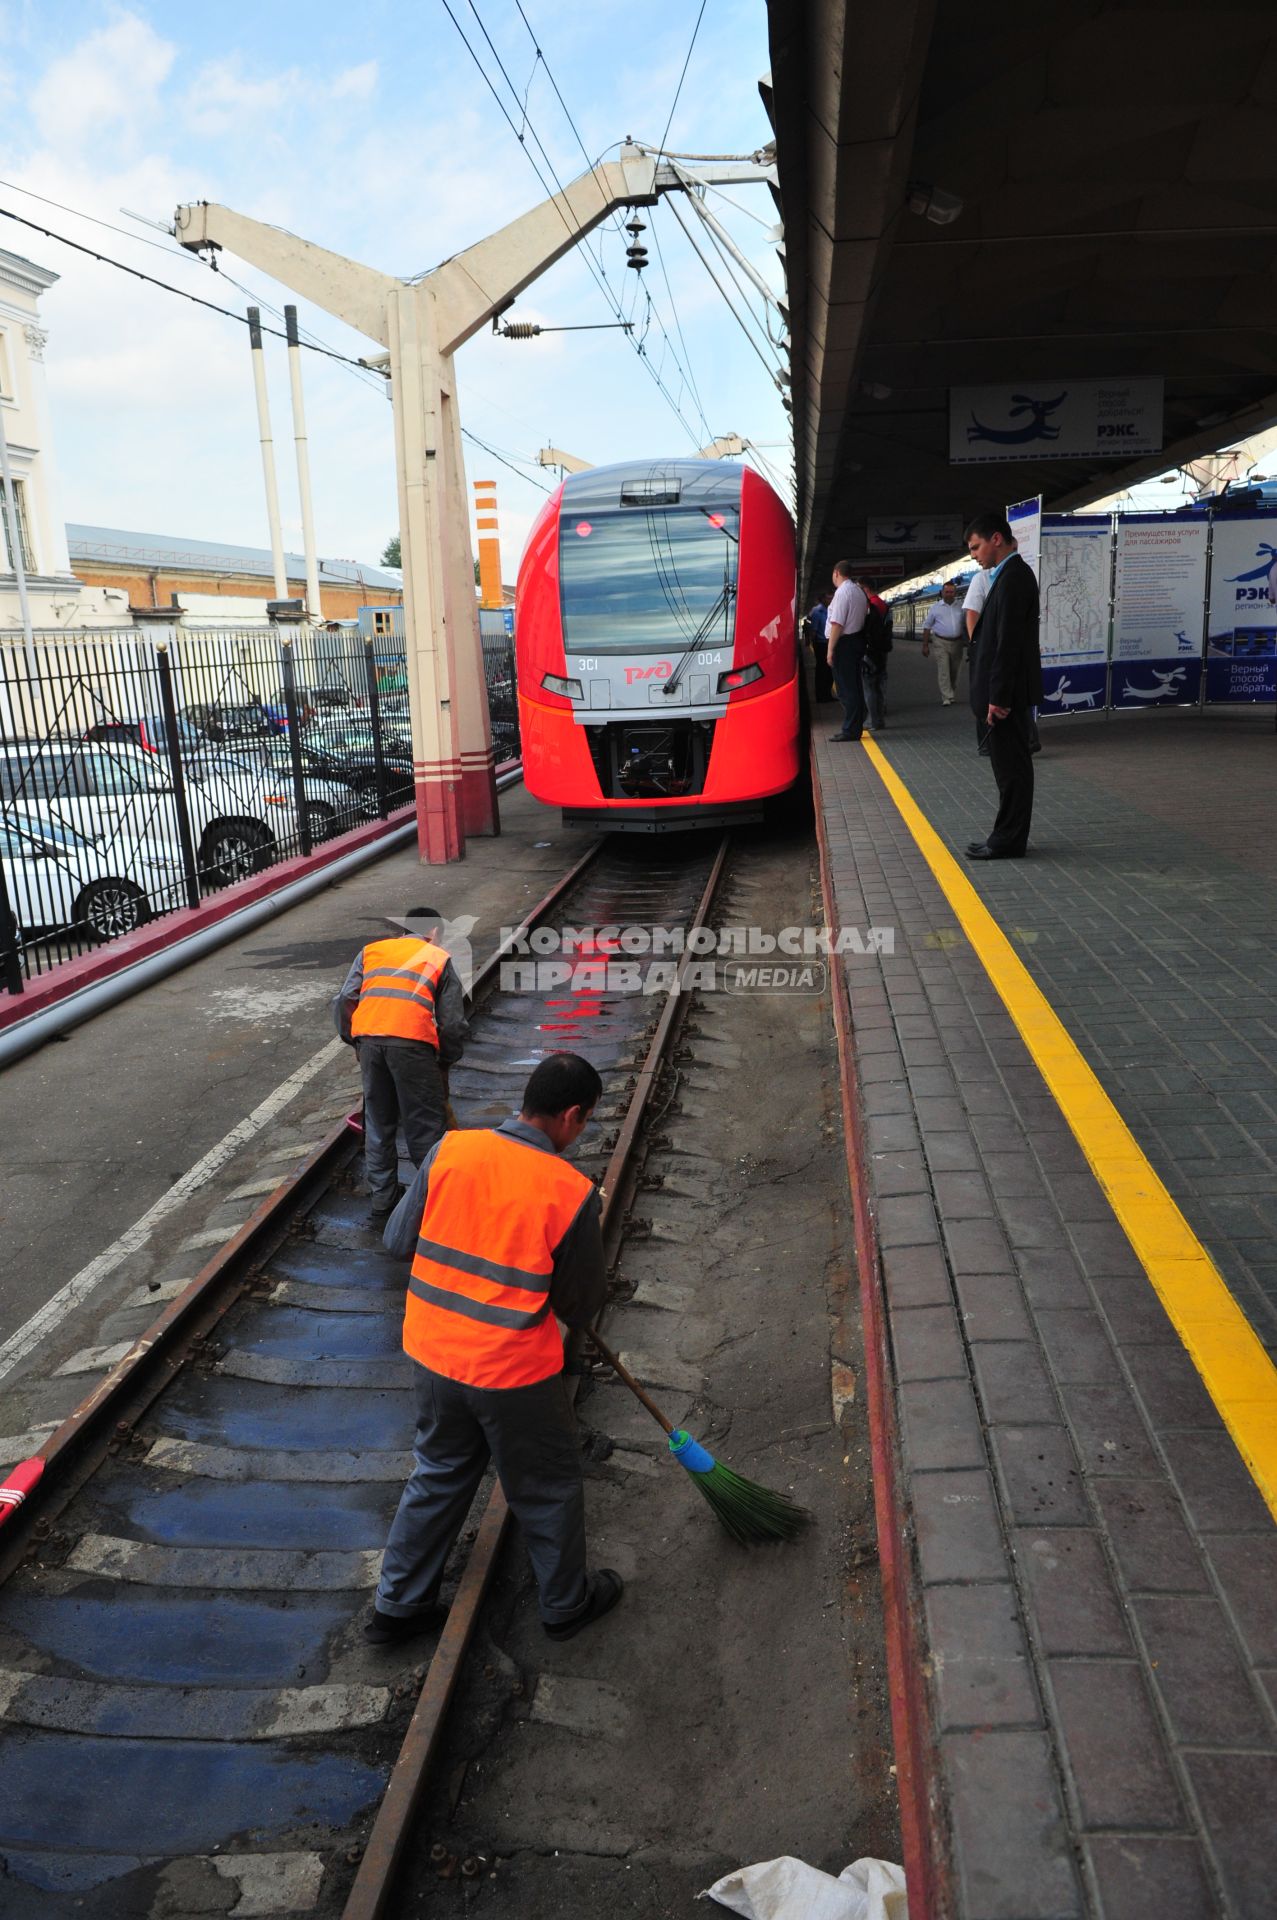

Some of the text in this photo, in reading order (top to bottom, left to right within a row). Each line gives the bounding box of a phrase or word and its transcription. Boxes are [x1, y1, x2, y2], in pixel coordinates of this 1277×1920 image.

[1124, 528, 1200, 538] Преимущества услуги
[1139, 538, 1182, 546] пассажиров
[1236, 587, 1270, 601] РЭК
[698, 653, 722, 665] 004
[1231, 663, 1269, 675] Верный
[1230, 673, 1265, 683] способ
[1229, 683, 1277, 695] добратьс
